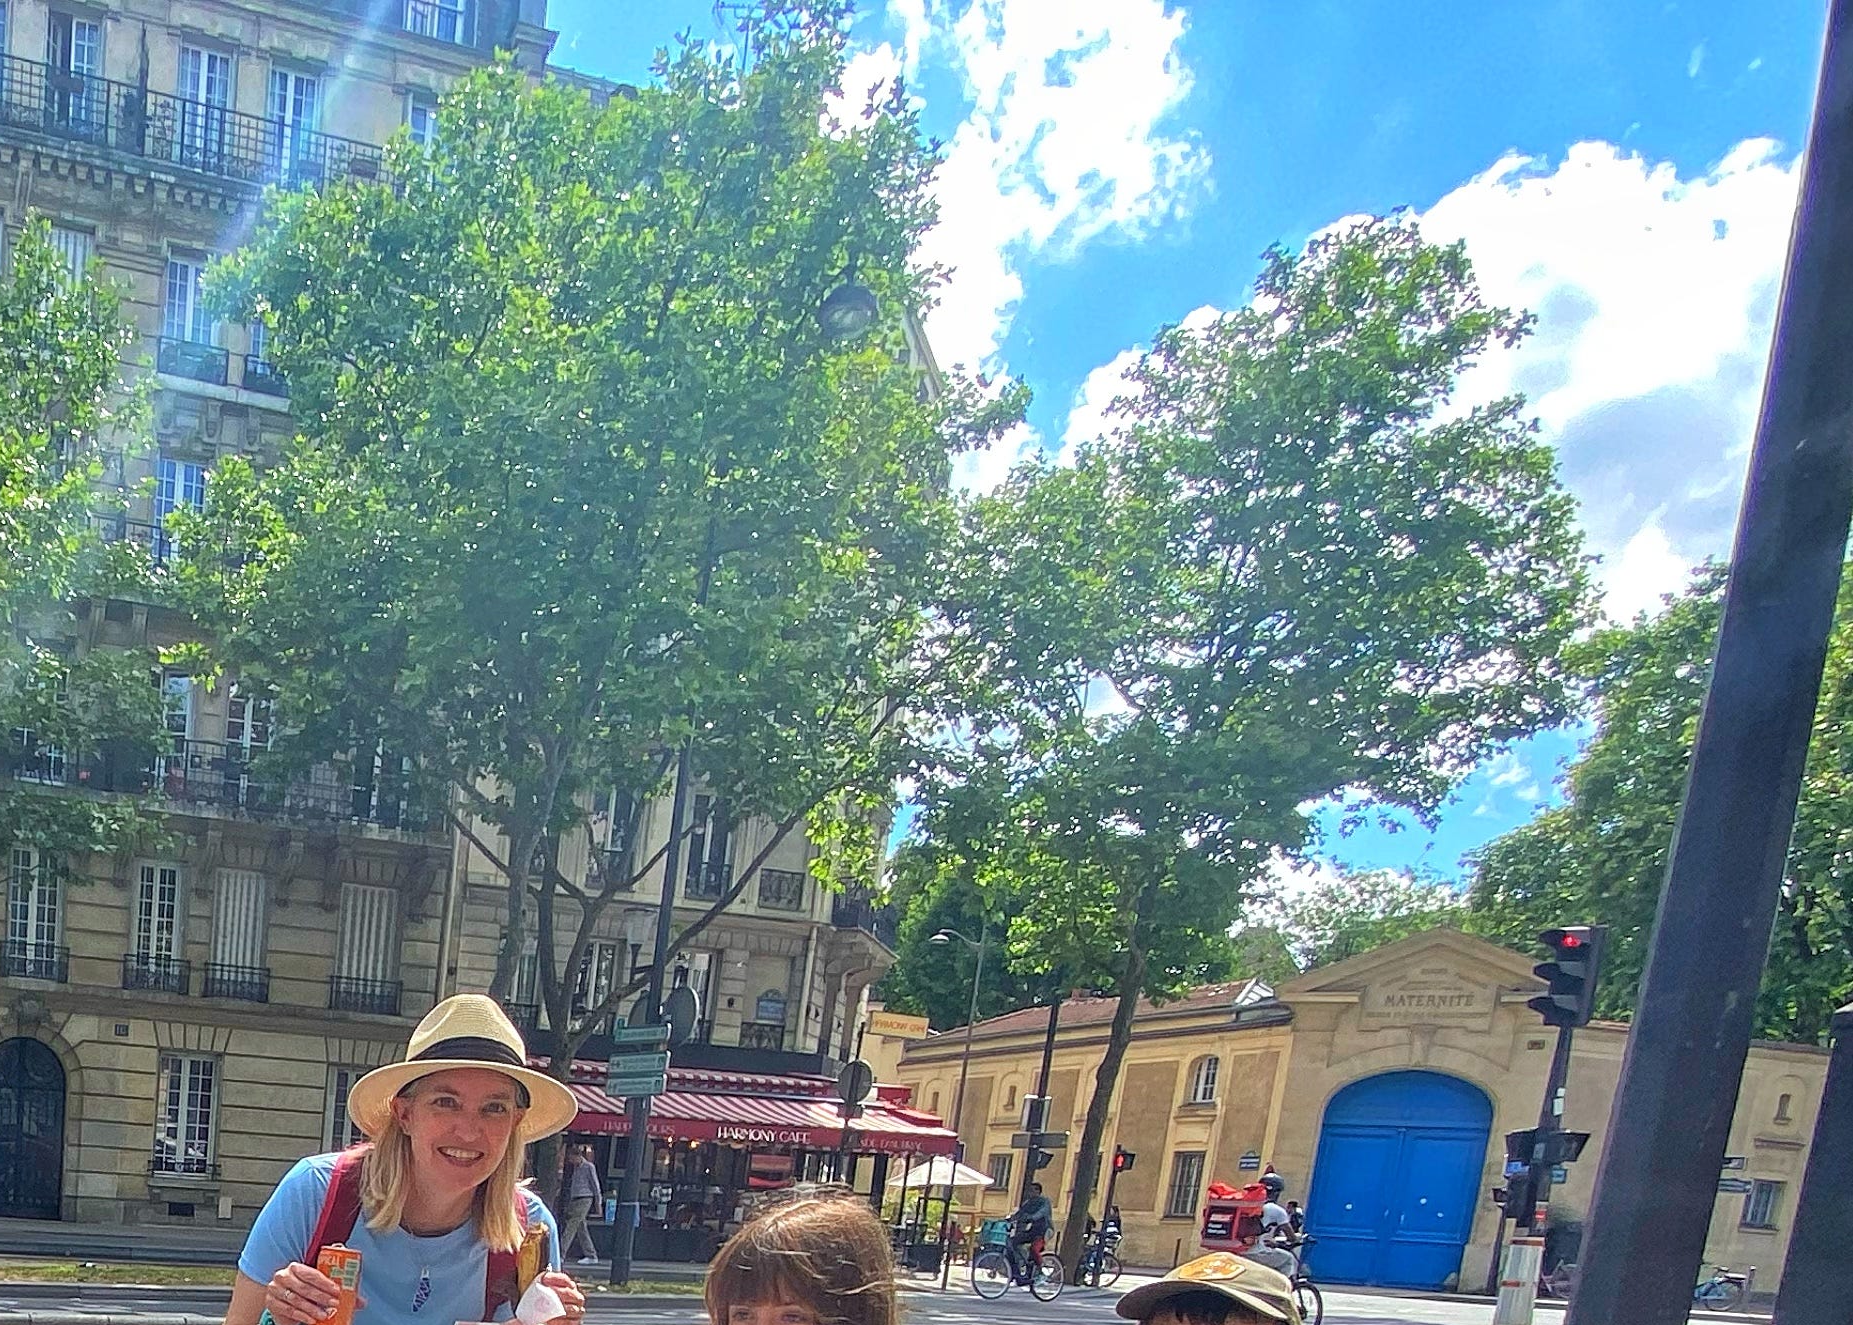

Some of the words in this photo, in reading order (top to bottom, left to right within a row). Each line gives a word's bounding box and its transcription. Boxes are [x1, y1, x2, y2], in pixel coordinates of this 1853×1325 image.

[603, 1121, 633, 1132] HAPP
[646, 1123, 676, 1134] OURS
[717, 1126, 777, 1142] HARMONY
